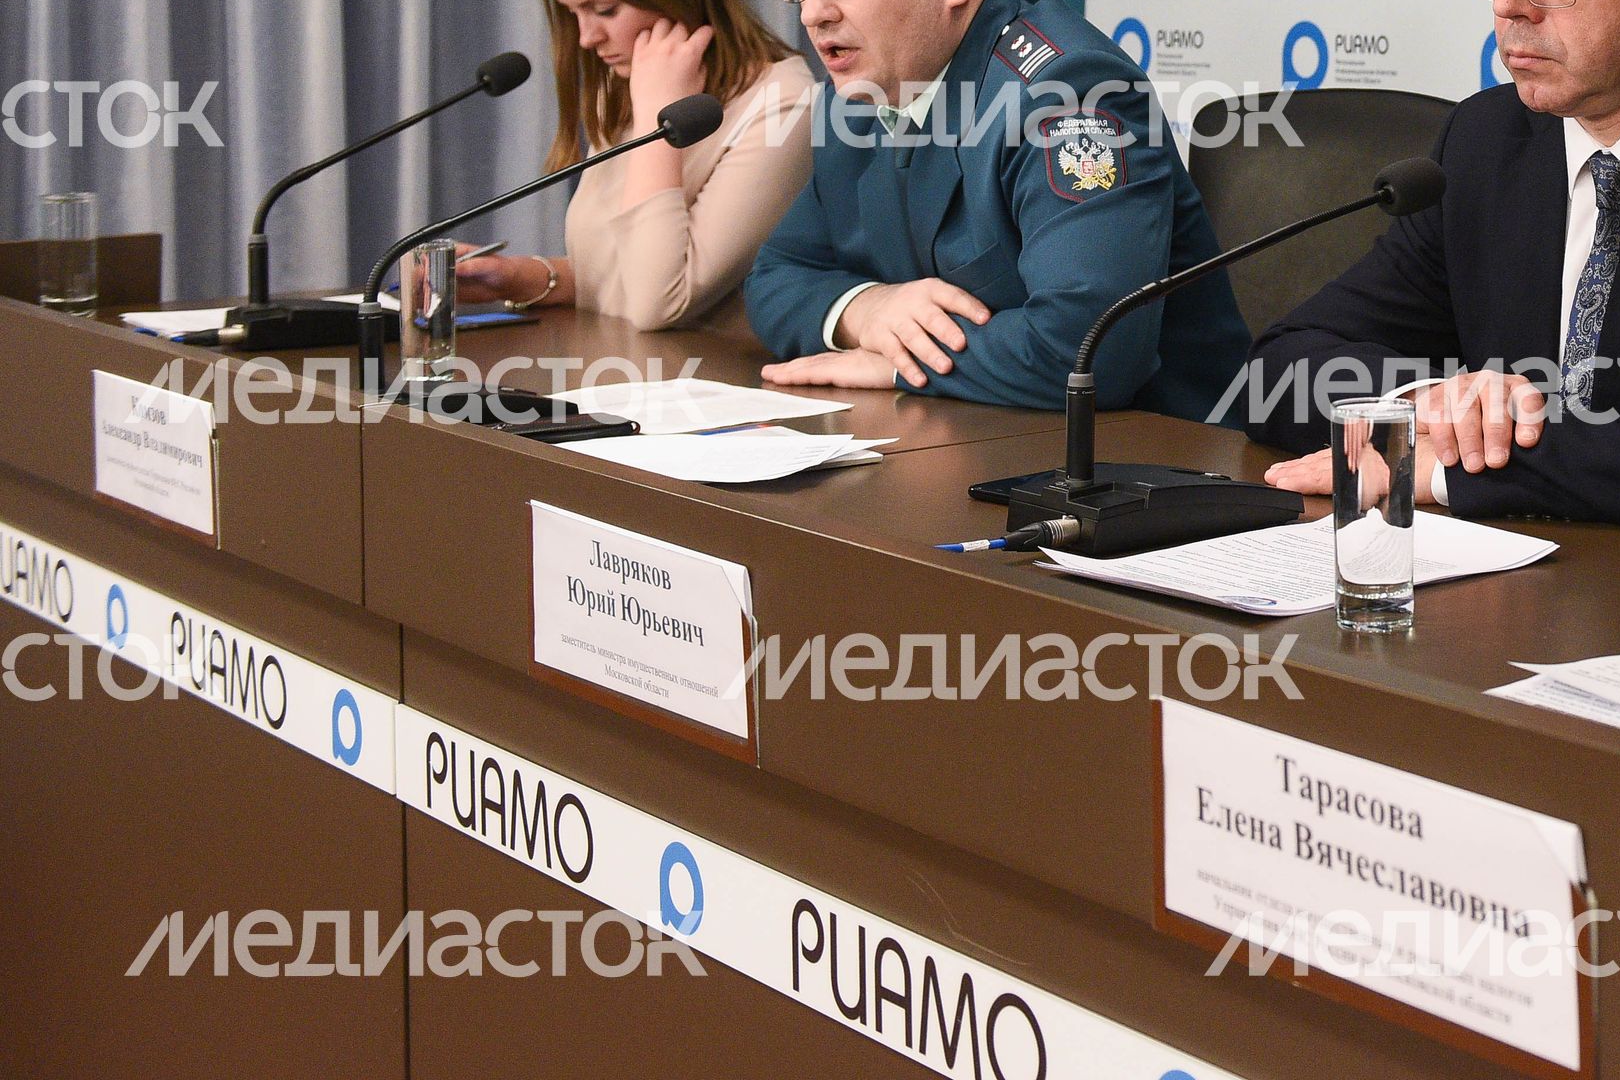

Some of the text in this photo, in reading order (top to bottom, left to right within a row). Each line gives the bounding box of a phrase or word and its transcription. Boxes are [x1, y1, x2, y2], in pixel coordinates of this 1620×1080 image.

[1156, 29, 1204, 49] РИАМО
[1335, 34, 1389, 55] РИАМО
[1057, 118, 1108, 128] ФЕДЕРАЛЬНАЯ
[589, 539, 672, 591] Лавряков
[566, 574, 705, 647] Юрий Юрьевич
[171, 610, 287, 730] РИАМО
[560, 633, 597, 654] заместитель
[597, 646, 627, 667] министра
[679, 677, 719, 699] отношений
[604, 663, 670, 699] Московской области
[425, 730, 594, 886] РИАМО
[1275, 753, 1425, 841] Тарасова
[1195, 785, 1283, 853] Елена
[1293, 820, 1531, 940] Вячеславовна
[792, 899, 1047, 1080] РИАМО
